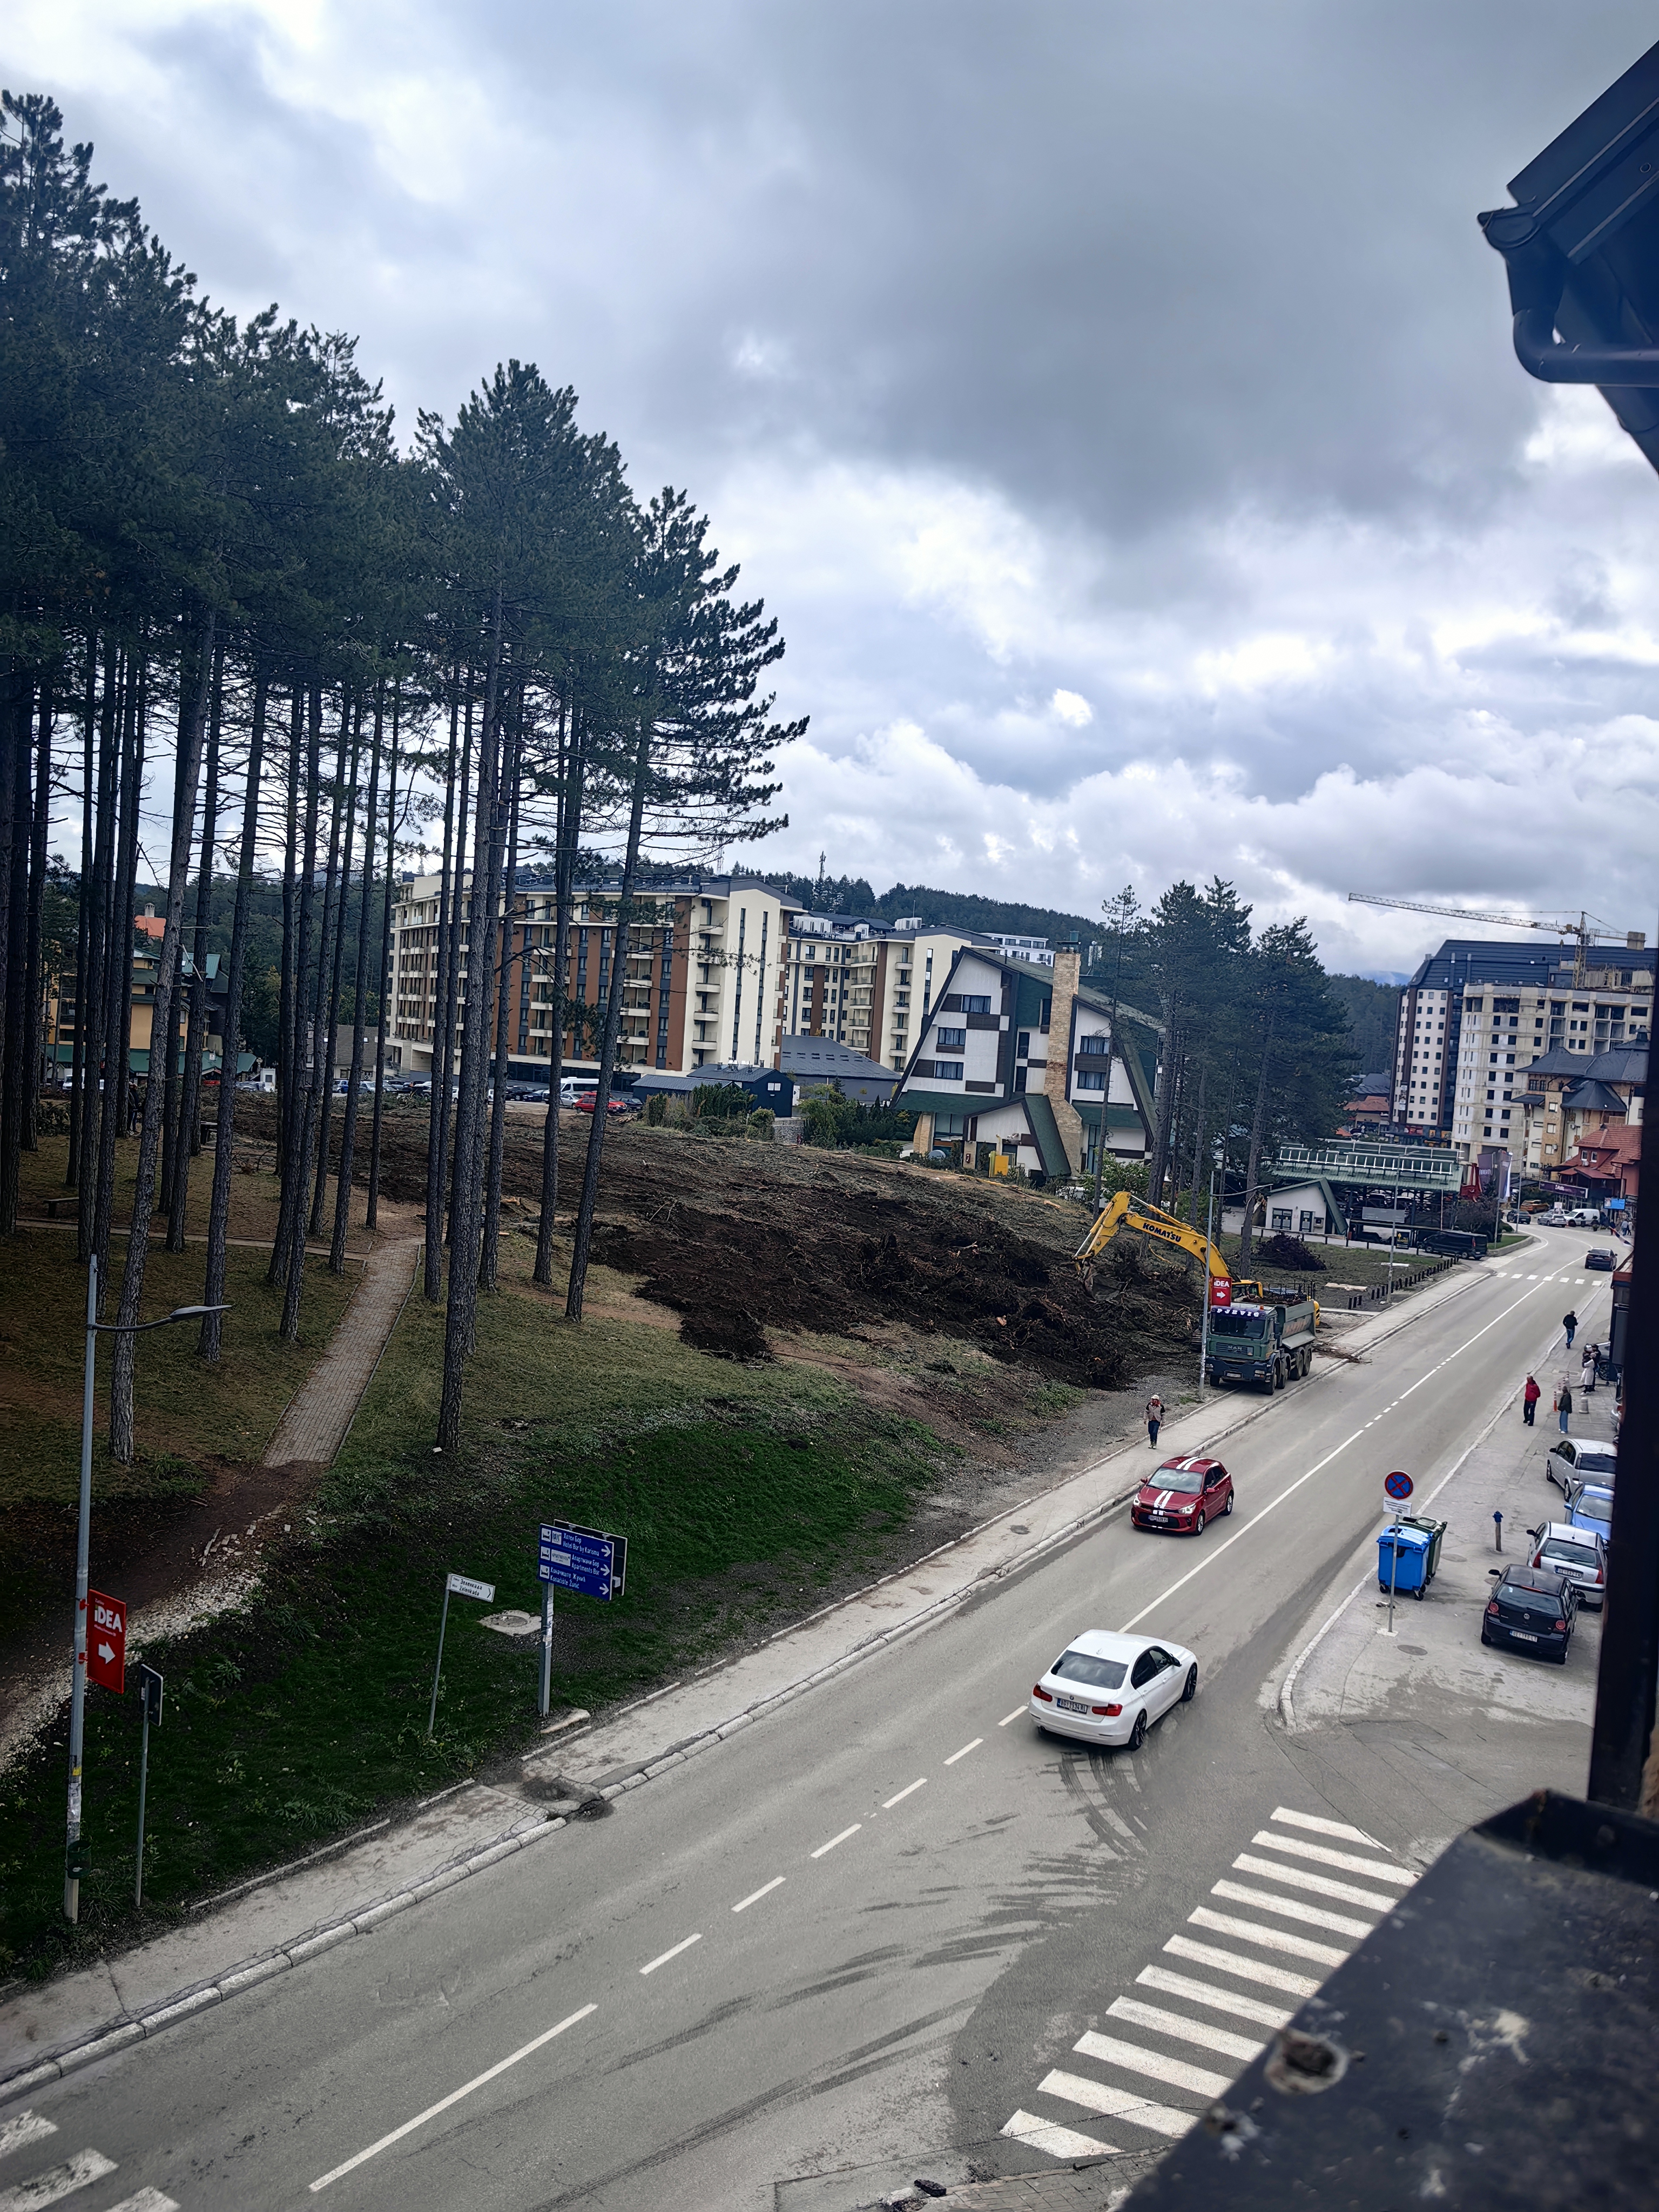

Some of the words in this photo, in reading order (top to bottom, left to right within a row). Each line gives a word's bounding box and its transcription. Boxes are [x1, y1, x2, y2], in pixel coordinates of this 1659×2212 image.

[1143, 1223, 1182, 1242] KOMATSU
[563, 1541, 572, 1549] Hotel
[579, 1545, 584, 1554] by
[585, 1547, 599, 1556] Karisma
[571, 1562, 593, 1573] Apartments
